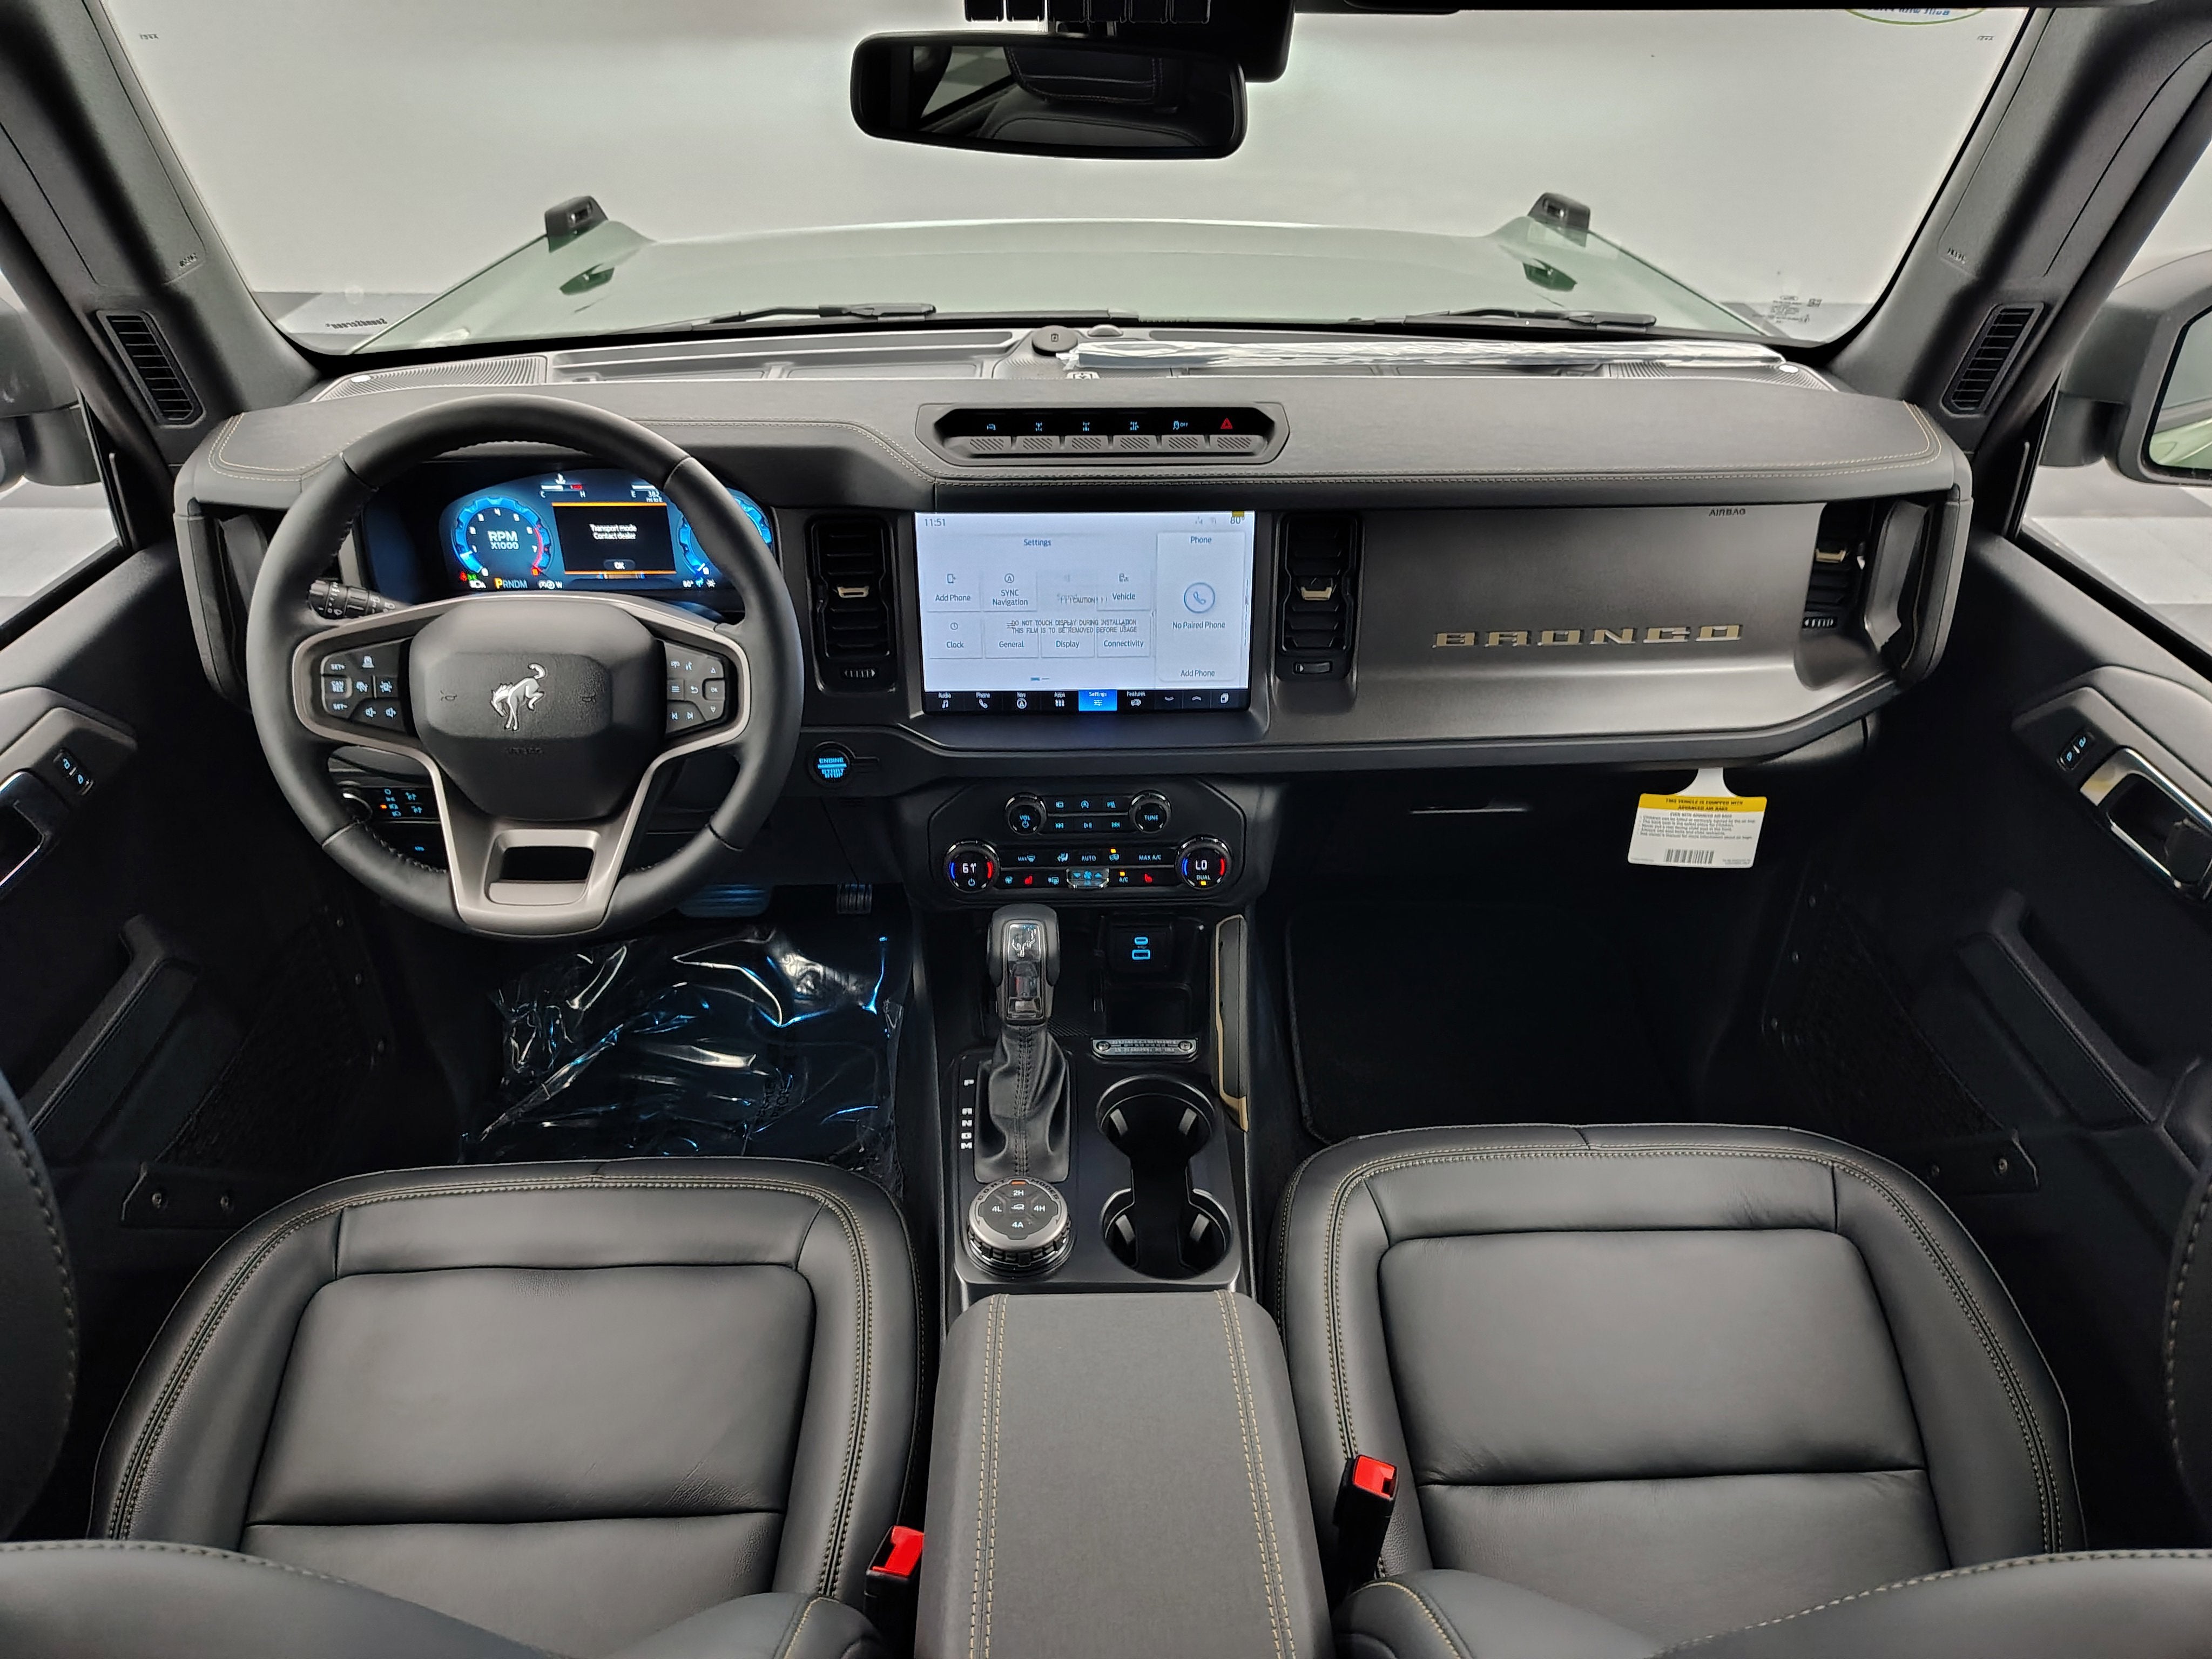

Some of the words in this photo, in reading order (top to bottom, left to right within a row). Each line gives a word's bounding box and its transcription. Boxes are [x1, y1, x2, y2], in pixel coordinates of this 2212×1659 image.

[1709, 508, 1746, 517] AIRBAG
[924, 518, 946, 527] 11:51
[589, 523, 618, 532] Transport
[619, 524, 637, 532] mode
[488, 530, 518, 542] RPM
[491, 542, 519, 550] X1000
[1023, 538, 1051, 547] Settings
[992, 598, 1028, 606] Navigation
[1432, 624, 1743, 648] BRONCO
[1195, 860, 1208, 871] LO
[1030, 1179, 1060, 1200] MODES
